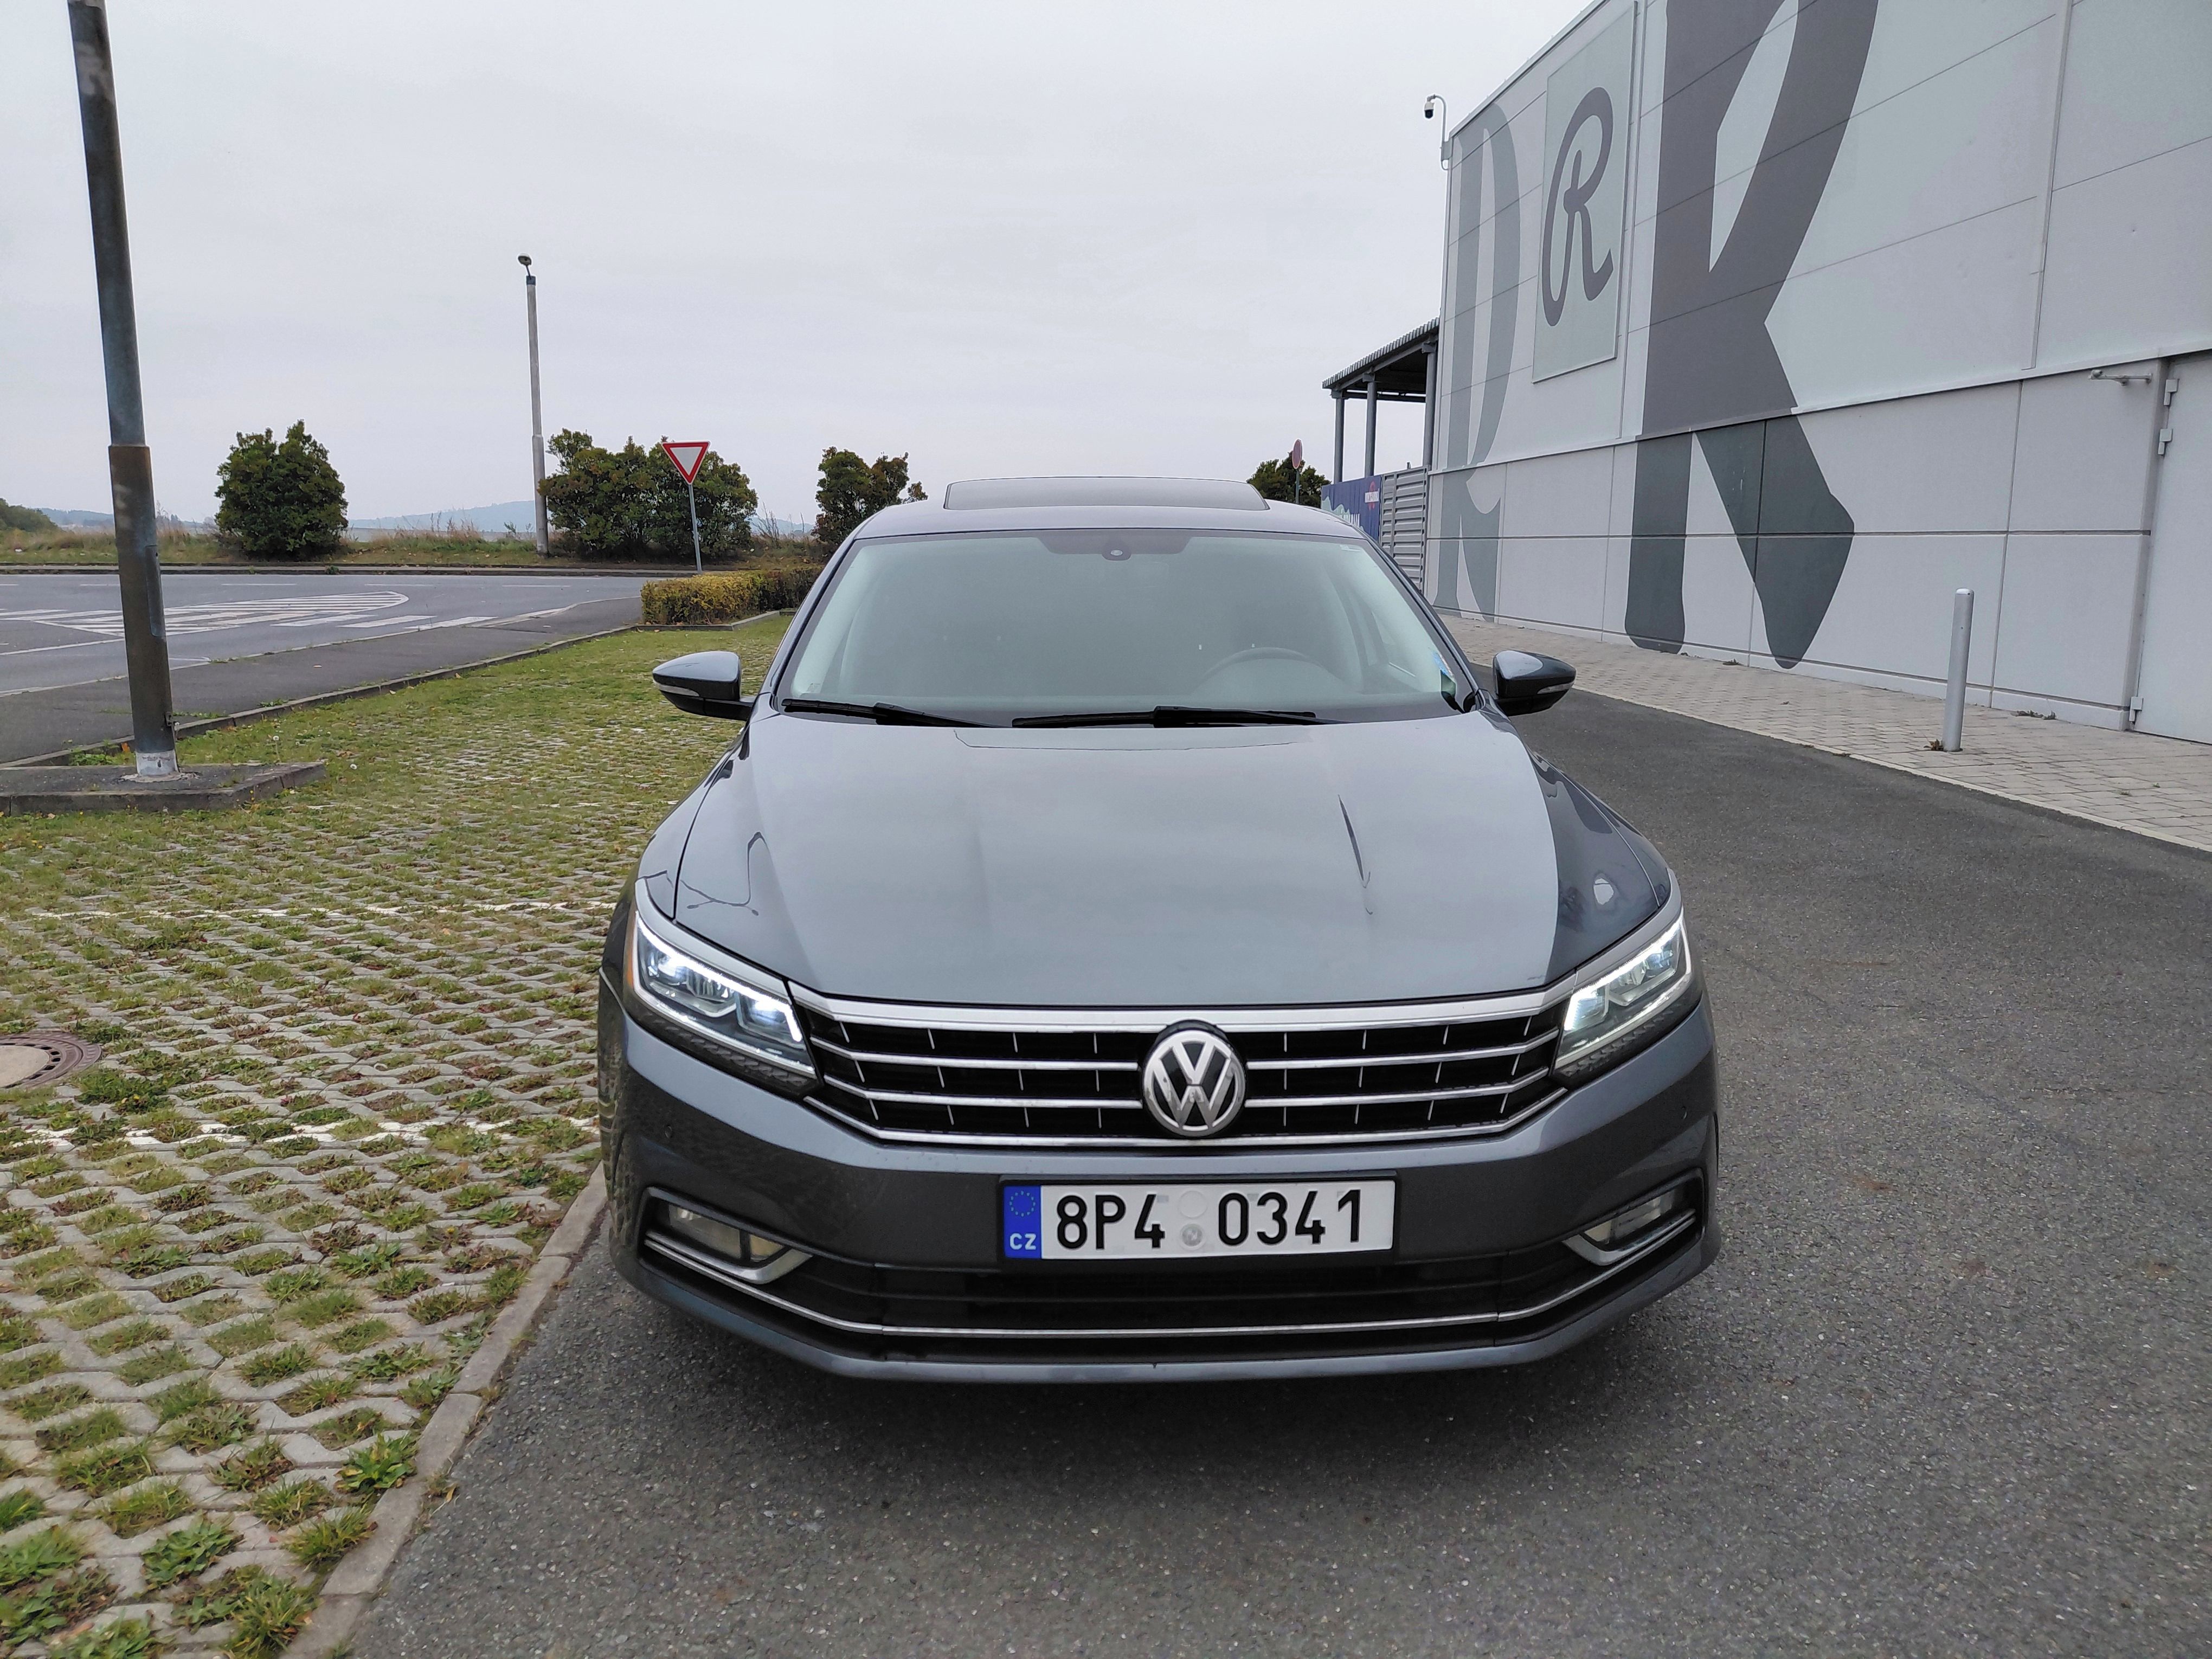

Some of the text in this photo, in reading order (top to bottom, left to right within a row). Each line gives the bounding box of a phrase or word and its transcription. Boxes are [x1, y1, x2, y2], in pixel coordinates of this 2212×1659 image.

[1542, 87, 1613, 326] R
[1009, 1233, 1037, 1250] CZ
[1057, 1189, 1361, 1250] 8P4 0341
